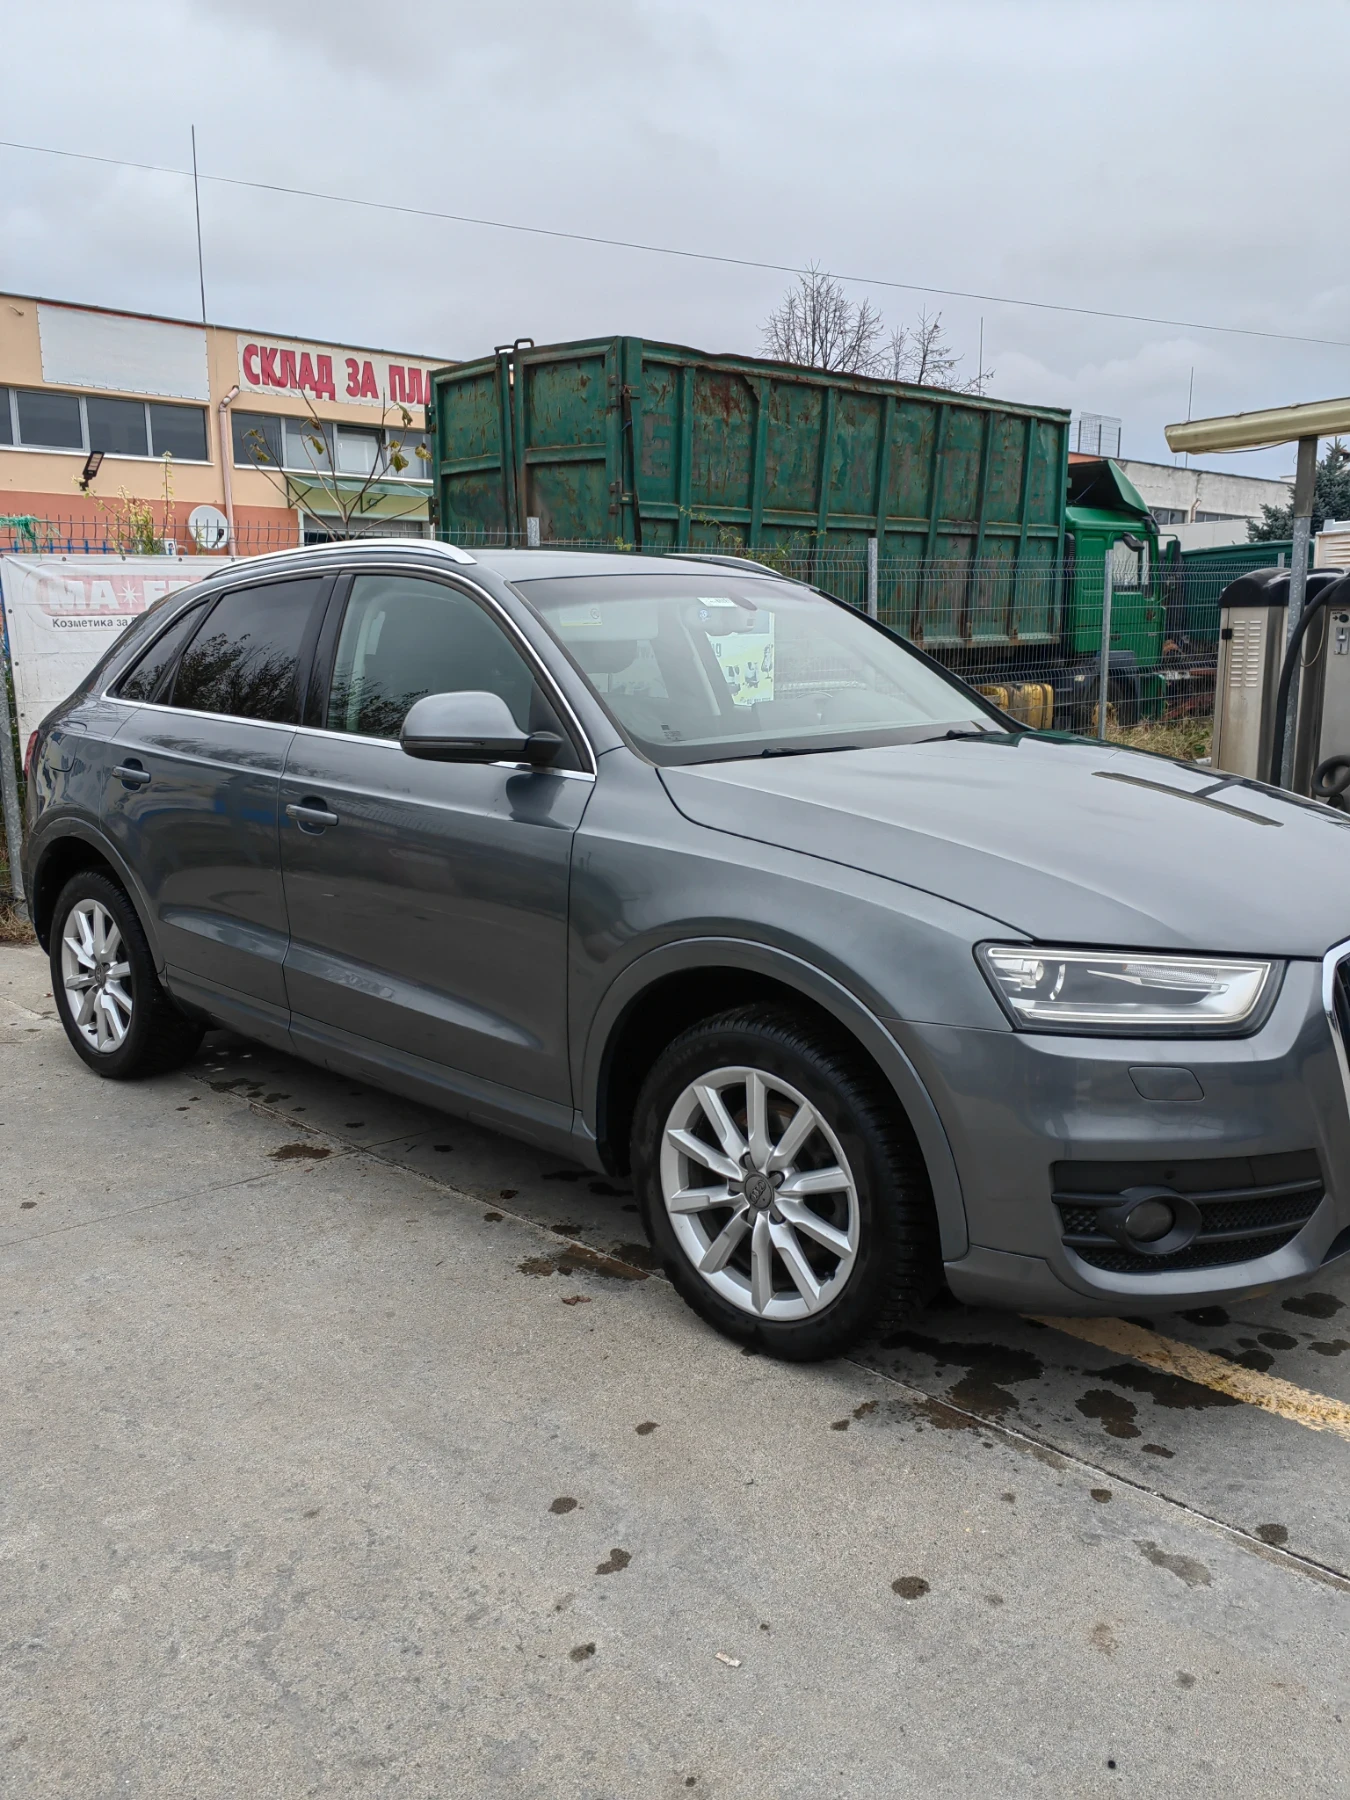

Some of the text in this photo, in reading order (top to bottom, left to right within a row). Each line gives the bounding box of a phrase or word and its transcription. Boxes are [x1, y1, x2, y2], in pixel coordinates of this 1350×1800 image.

[243, 344, 336, 401] СКЛАД
[345, 358, 379, 400] ЗА
[52, 618, 114, 628] Козметика
[116, 618, 129, 627] за
